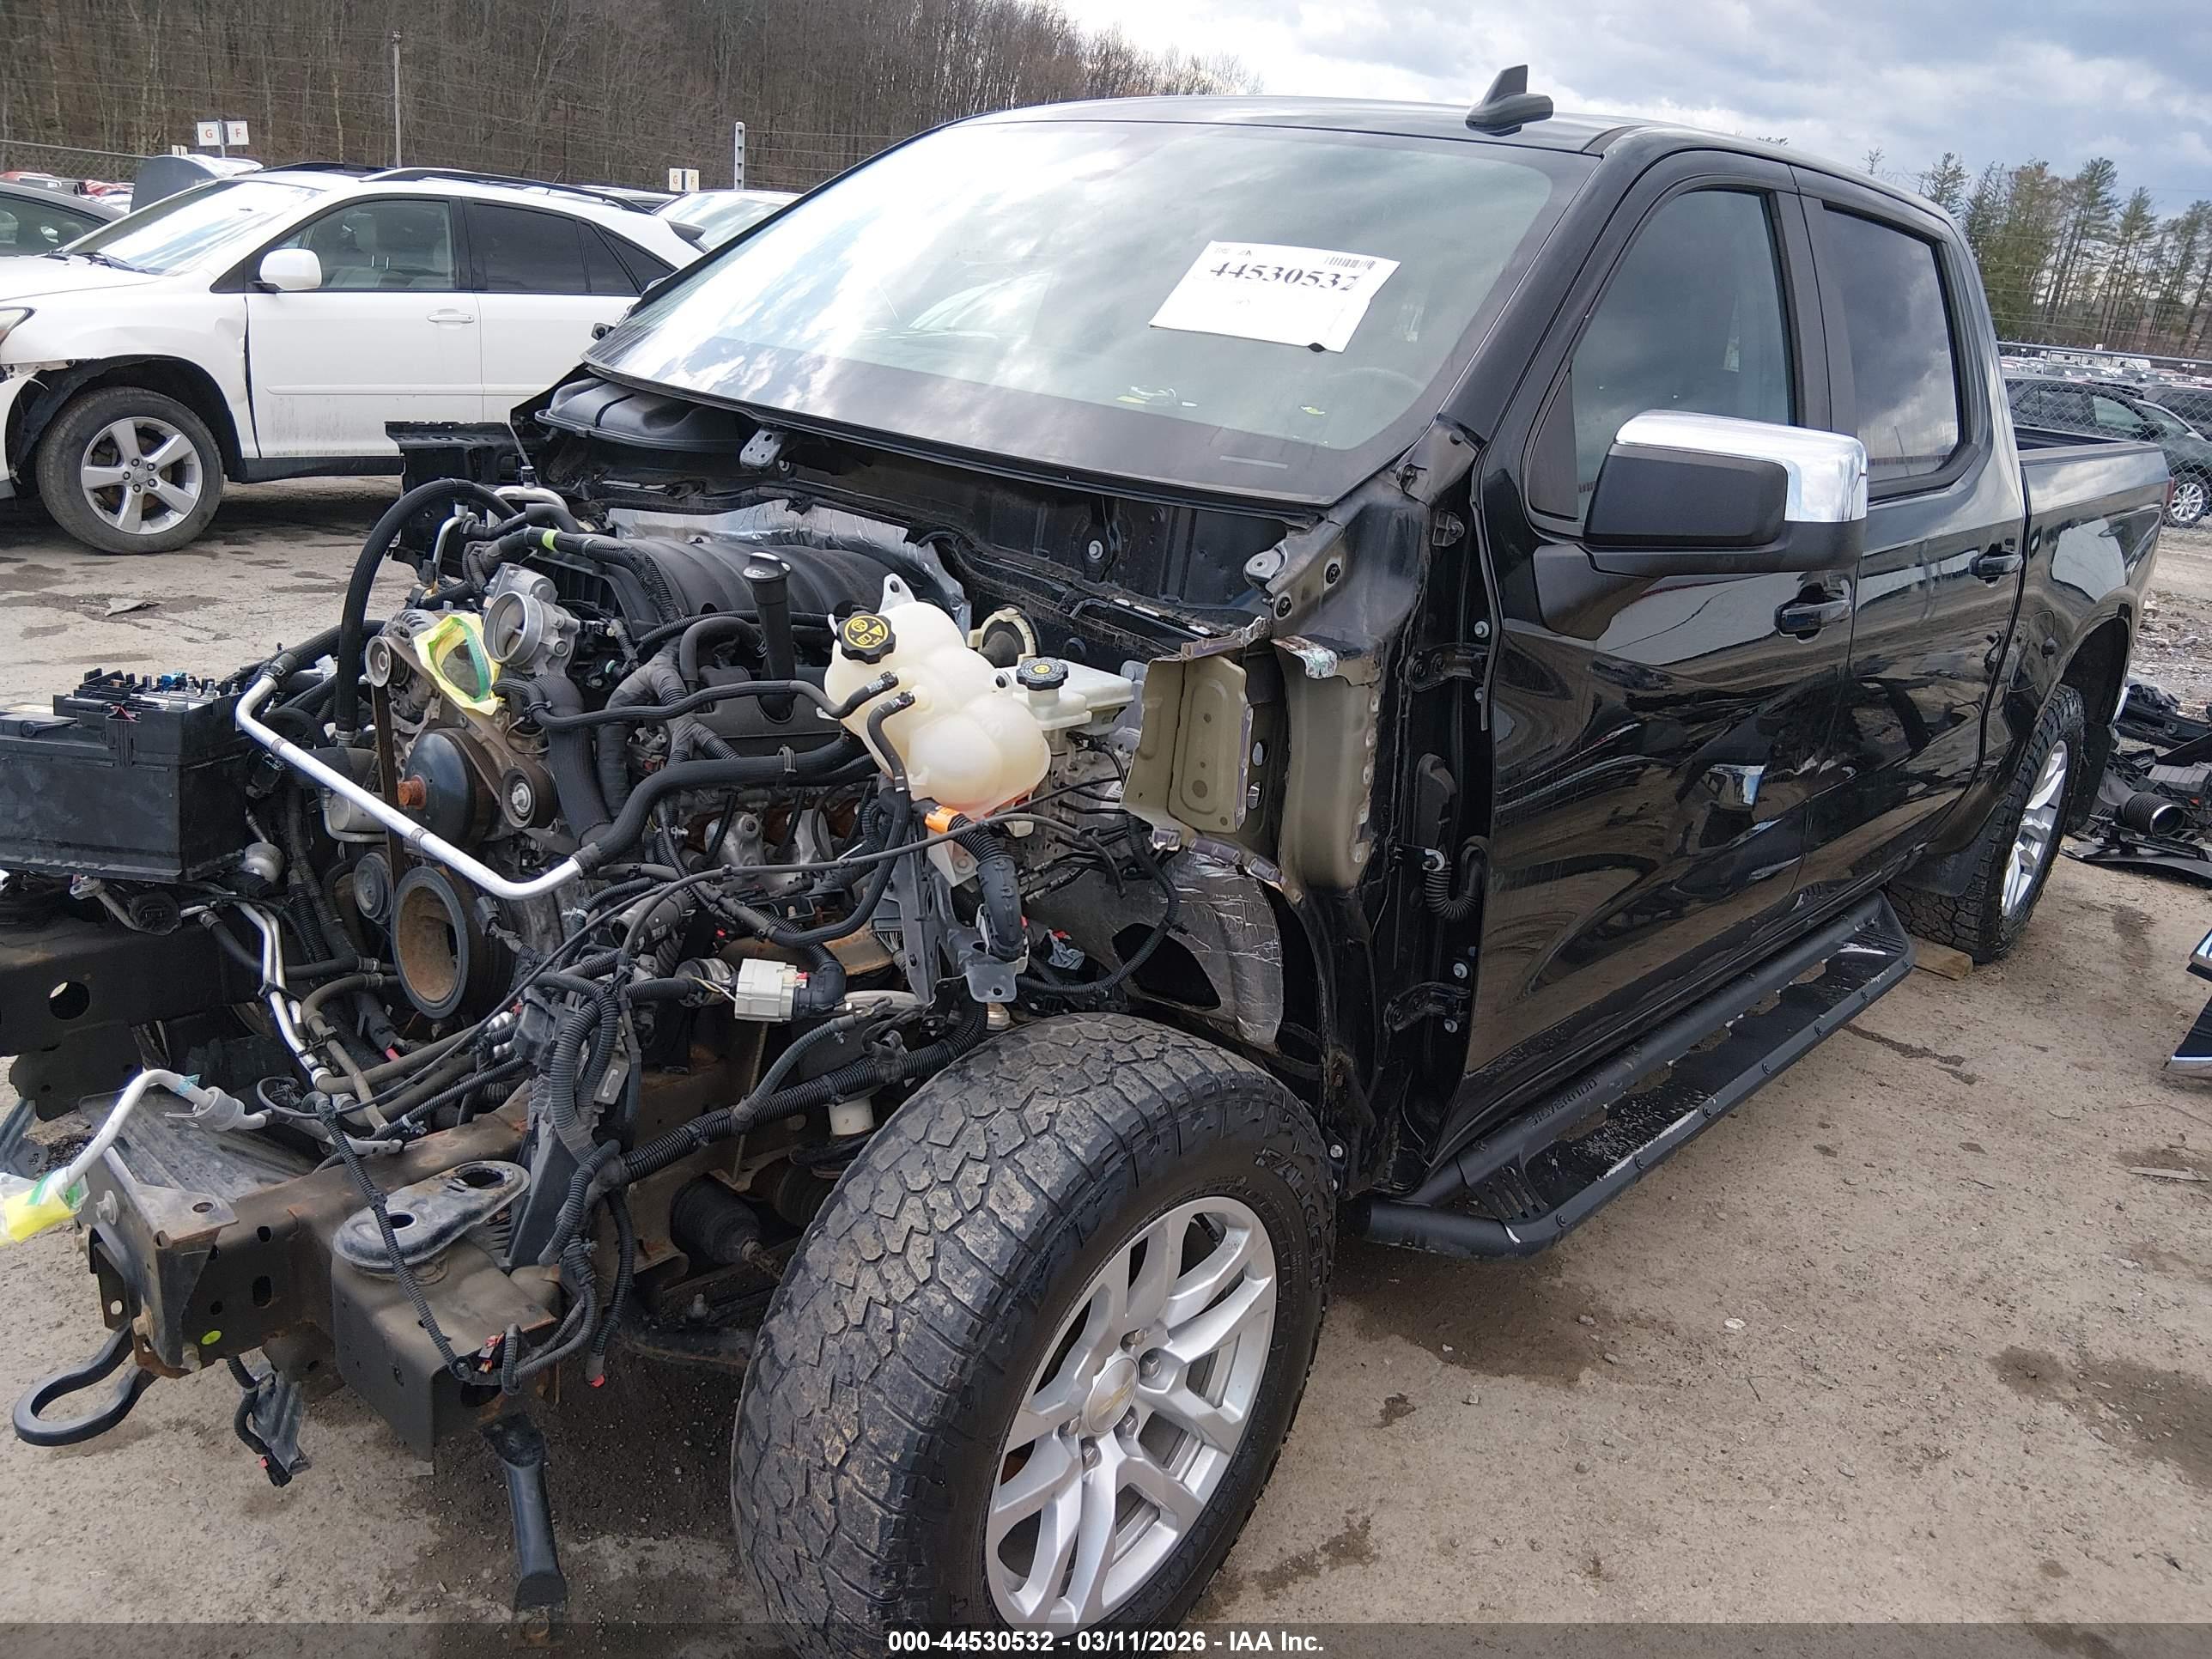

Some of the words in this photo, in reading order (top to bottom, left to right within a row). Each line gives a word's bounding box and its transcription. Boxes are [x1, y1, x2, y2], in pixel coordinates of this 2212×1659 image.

[205, 129, 213, 138] G
[234, 128, 241, 138] F
[1209, 261, 1360, 291] 44530532
